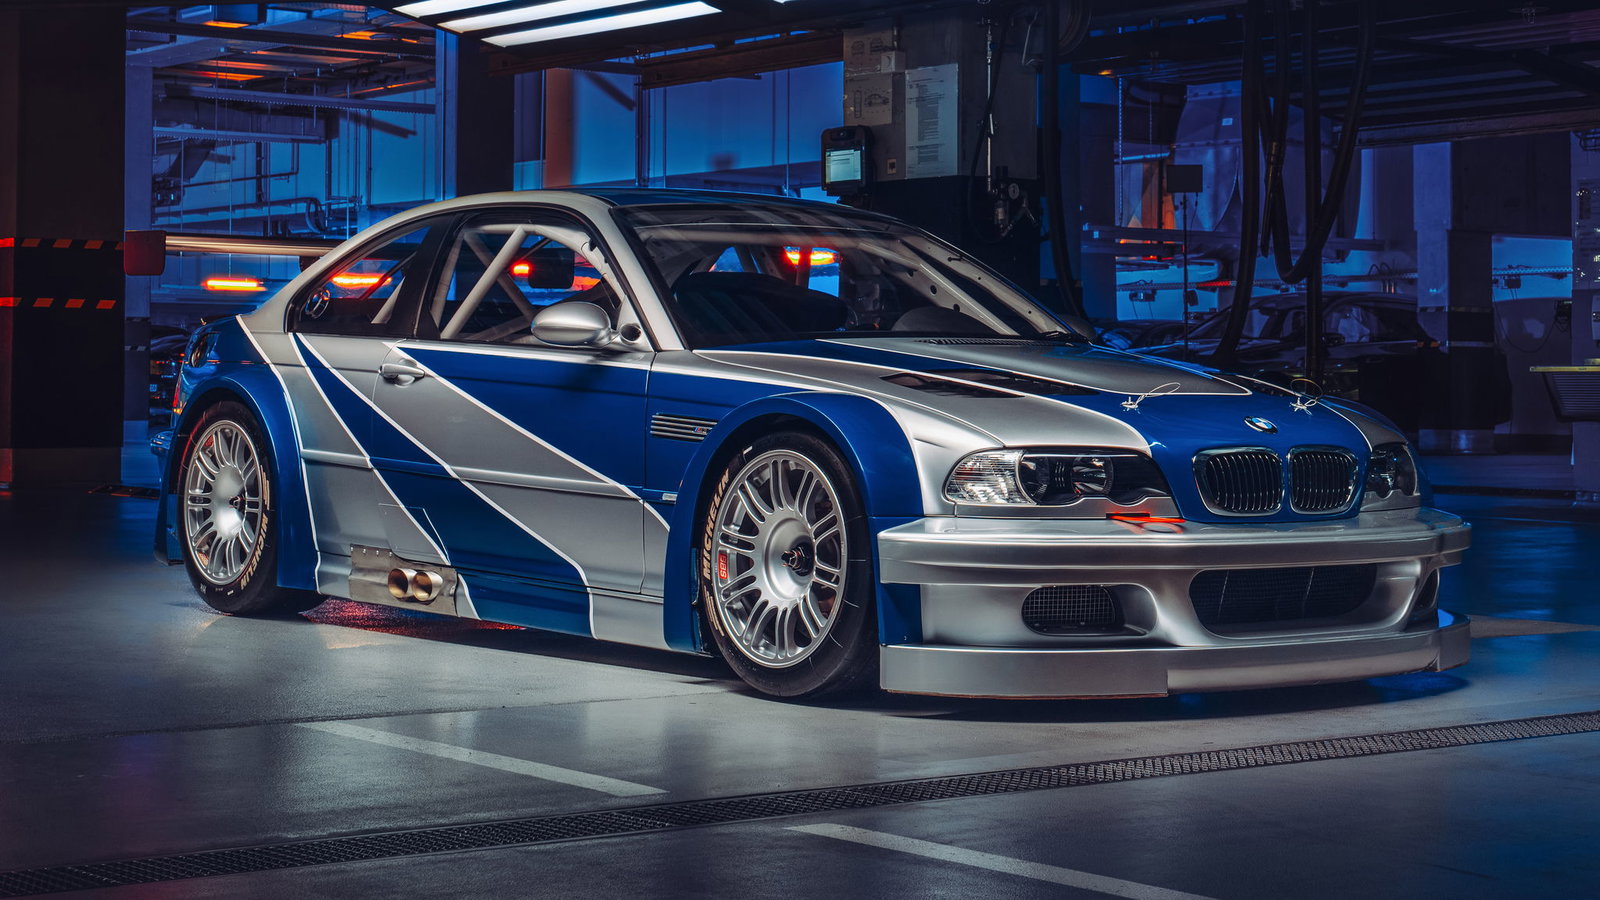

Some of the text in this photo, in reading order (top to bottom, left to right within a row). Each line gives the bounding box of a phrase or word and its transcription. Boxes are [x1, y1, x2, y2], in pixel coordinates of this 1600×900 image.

[240, 512, 269, 590] MICHELIN
[702, 468, 729, 580] MICHELIN
[719, 554, 727, 577] BBS
